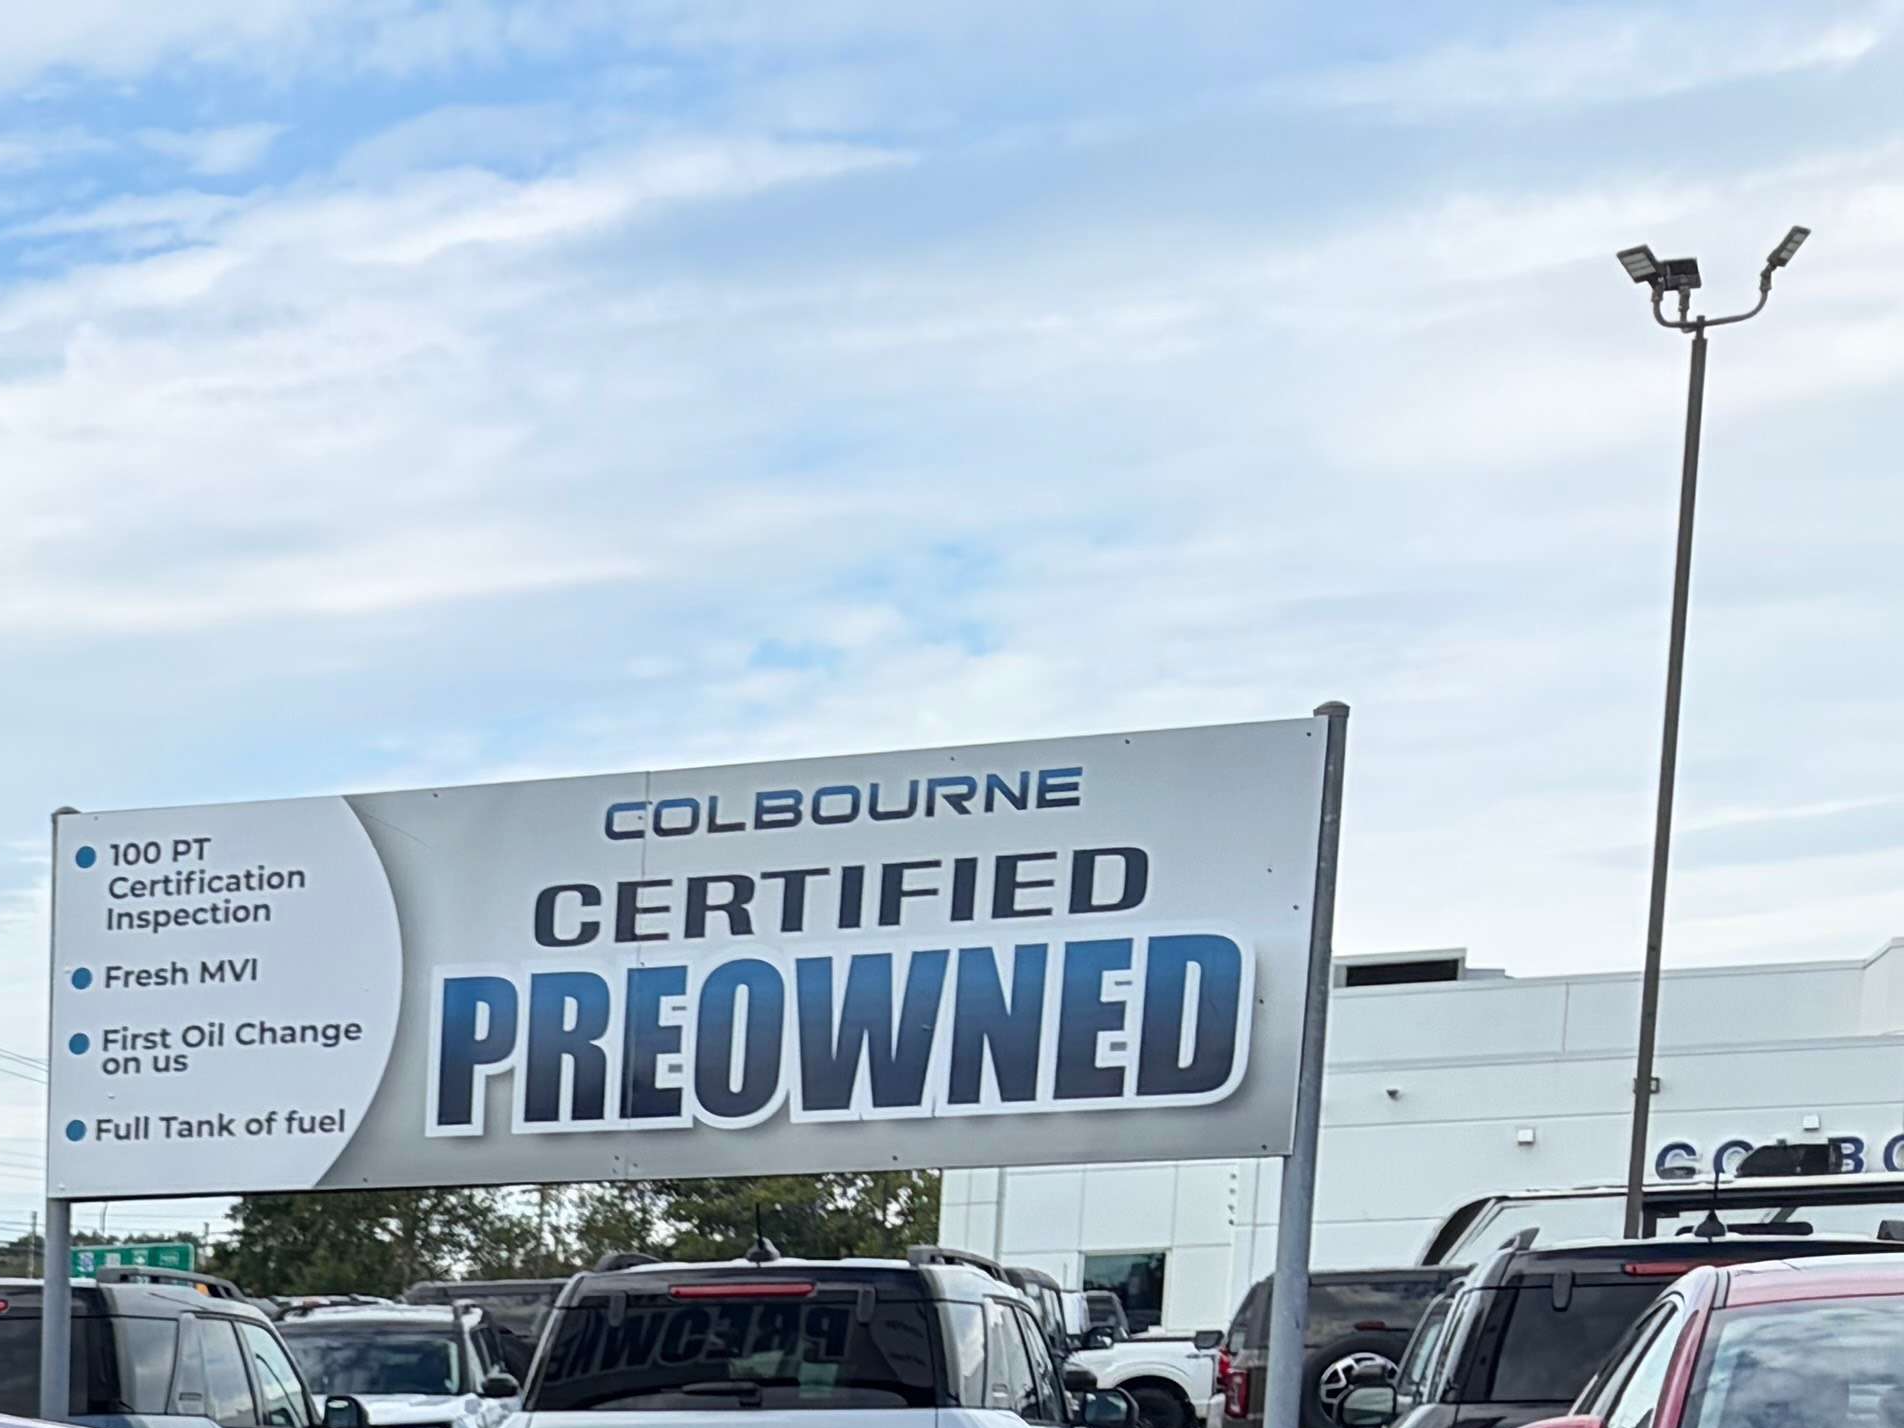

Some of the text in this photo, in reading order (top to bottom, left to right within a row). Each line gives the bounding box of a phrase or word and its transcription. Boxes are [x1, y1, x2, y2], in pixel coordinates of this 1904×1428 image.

[603, 765, 1084, 841] COLBOURNE
[109, 838, 211, 866] 100 PT
[108, 865, 306, 900] Certification
[533, 846, 1149, 948] CERTIFIED
[106, 899, 272, 934] Inspection
[103, 958, 259, 989] Fresh MVI
[102, 1020, 363, 1052] First Oil Change
[432, 930, 1247, 1132] PREOWNED
[102, 1052, 189, 1075] on us
[95, 1108, 346, 1141] Full Tank of fuel
